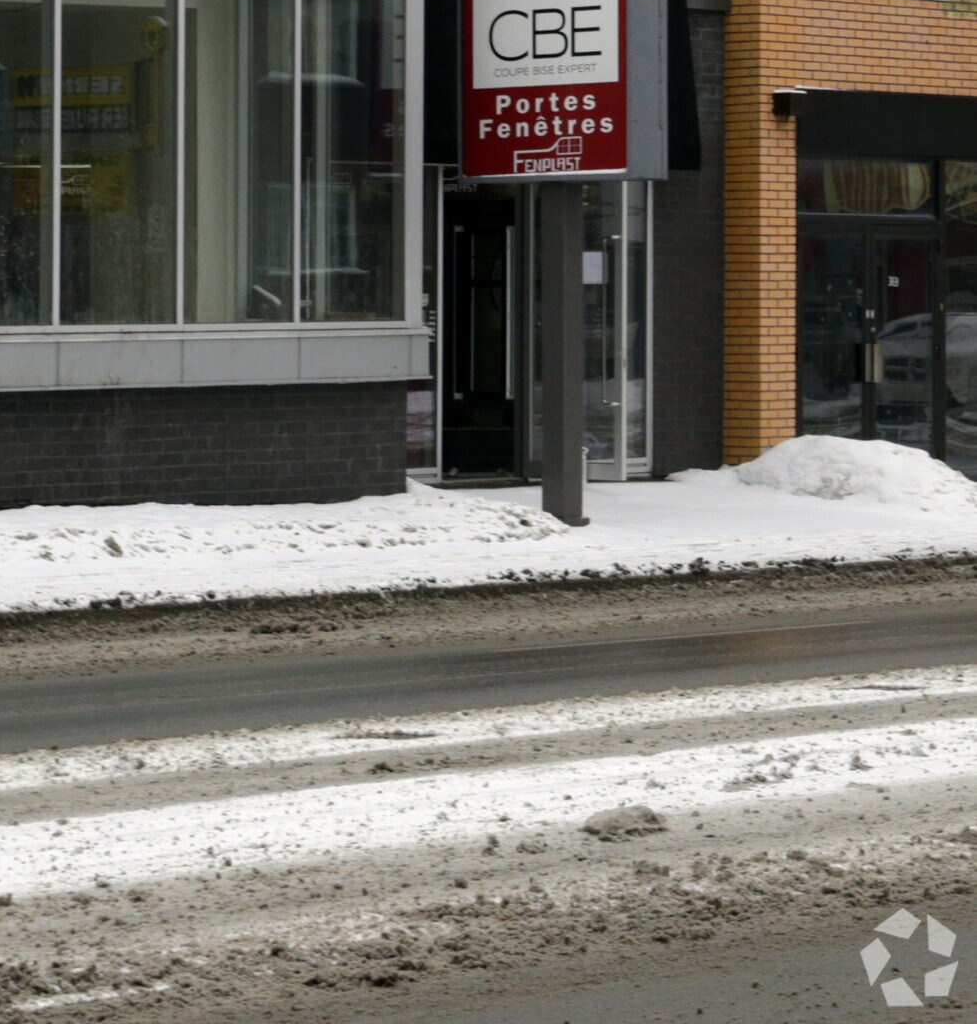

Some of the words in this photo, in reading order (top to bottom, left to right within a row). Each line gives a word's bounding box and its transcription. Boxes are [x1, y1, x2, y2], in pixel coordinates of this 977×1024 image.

[488, 5, 602, 62] CBE
[493, 67, 530, 78] COUPE
[533, 66, 554, 76] BISE
[557, 63, 597, 74] EXPERT
[495, 92, 596, 115] Portes
[479, 116, 614, 139] Fenêtres
[513, 151, 581, 173] FENPLAST
